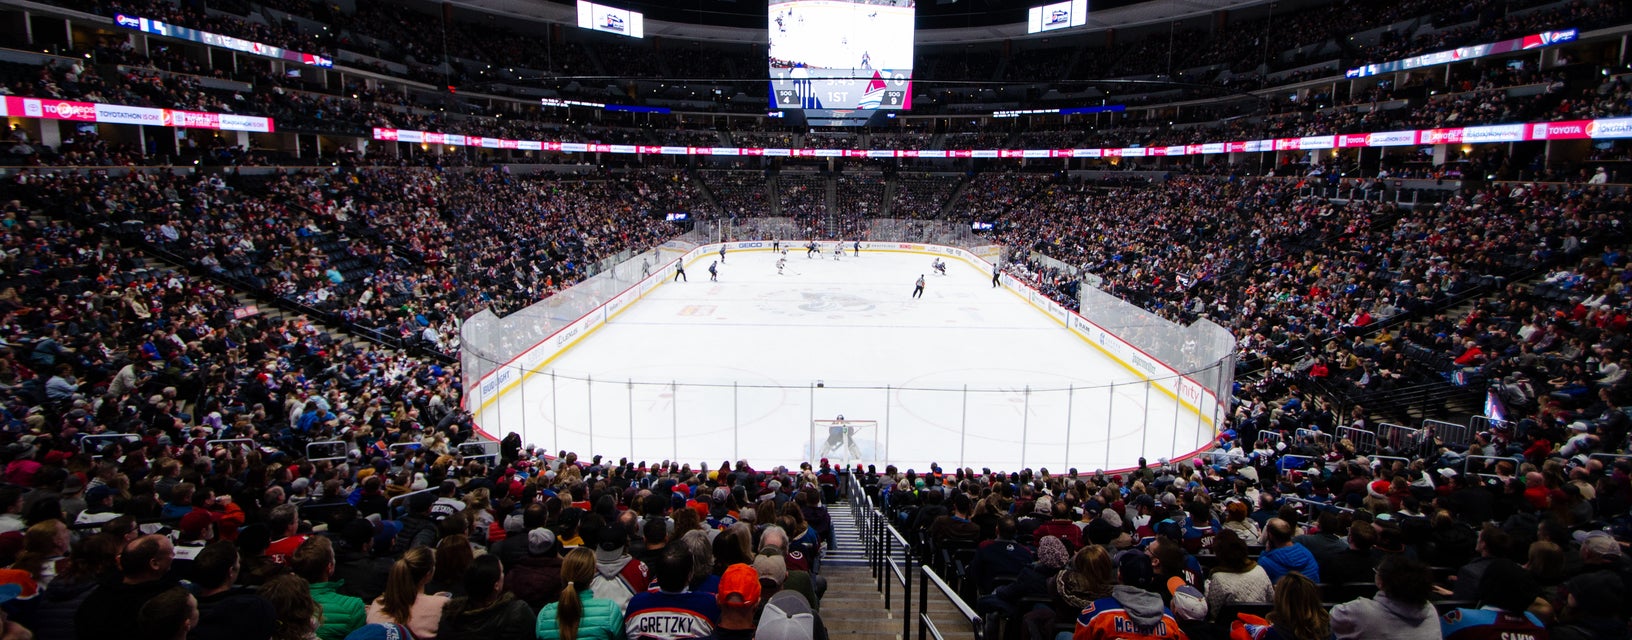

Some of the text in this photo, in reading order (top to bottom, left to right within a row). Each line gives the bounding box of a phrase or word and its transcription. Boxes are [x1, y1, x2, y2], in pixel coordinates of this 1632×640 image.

[827, 91, 848, 102] 1ST
[891, 97, 897, 105] 9
[99, 110, 142, 120] TOYOTATHON
[1548, 126, 1580, 135] TOYOTA
[640, 616, 694, 633] GRETZKY
